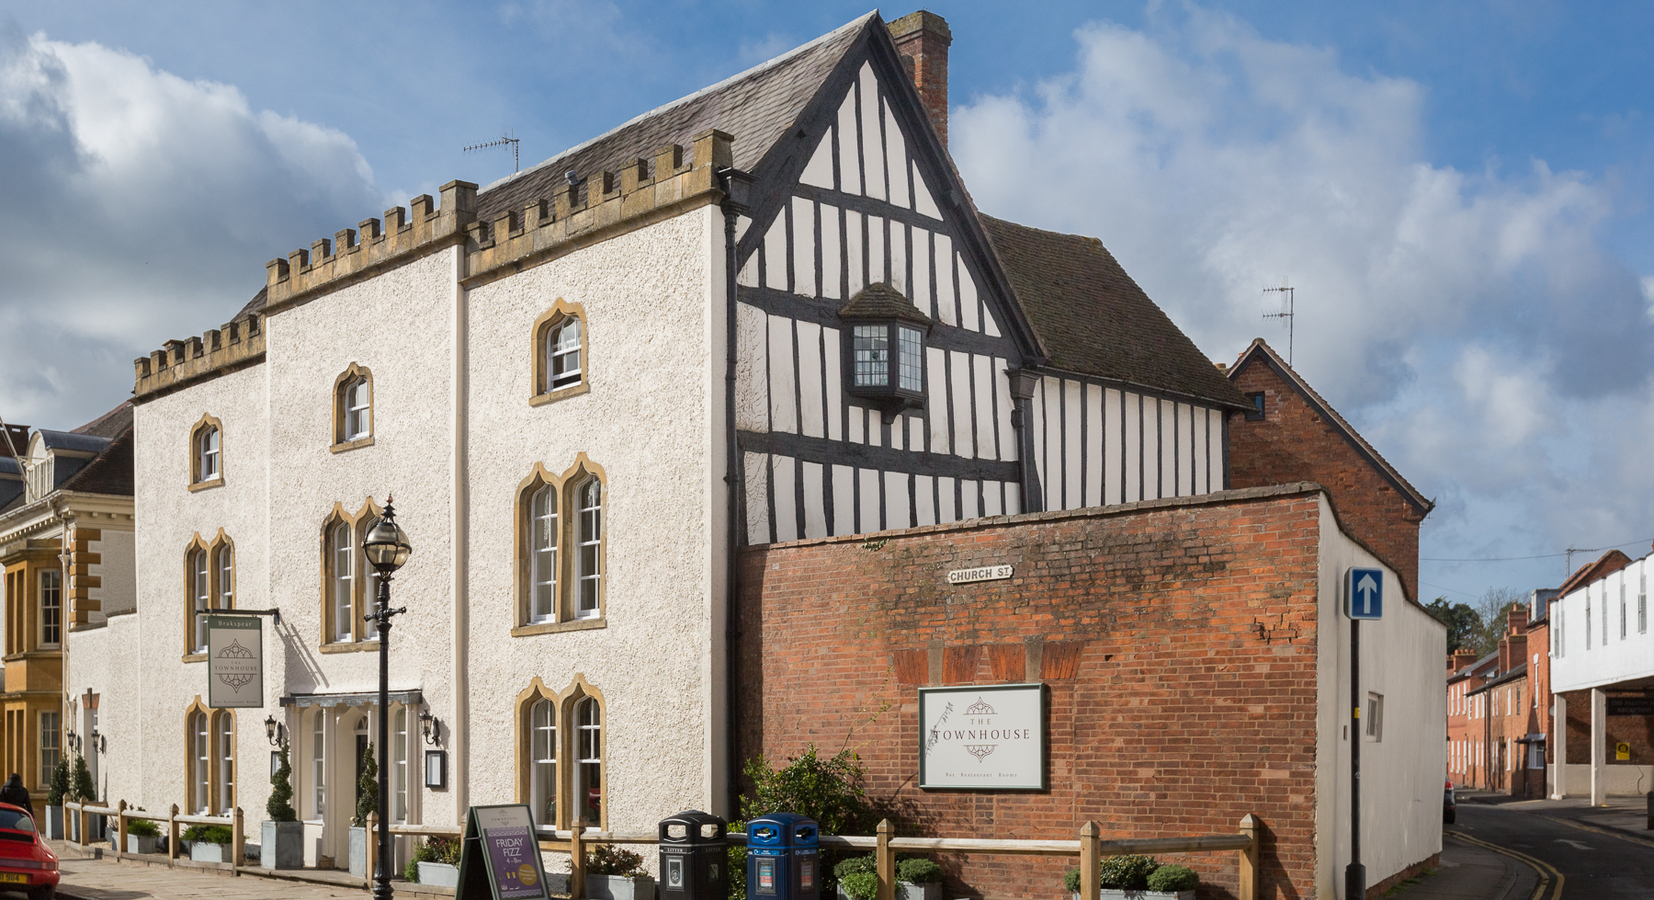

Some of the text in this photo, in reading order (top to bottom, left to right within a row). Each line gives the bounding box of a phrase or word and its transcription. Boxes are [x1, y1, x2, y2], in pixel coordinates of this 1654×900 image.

[951, 569, 992, 581] CHURCH
[934, 729, 1030, 740] TOWNHOUSE
[495, 838, 524, 848] FRIDAY
[502, 847, 522, 857] FIZZ
